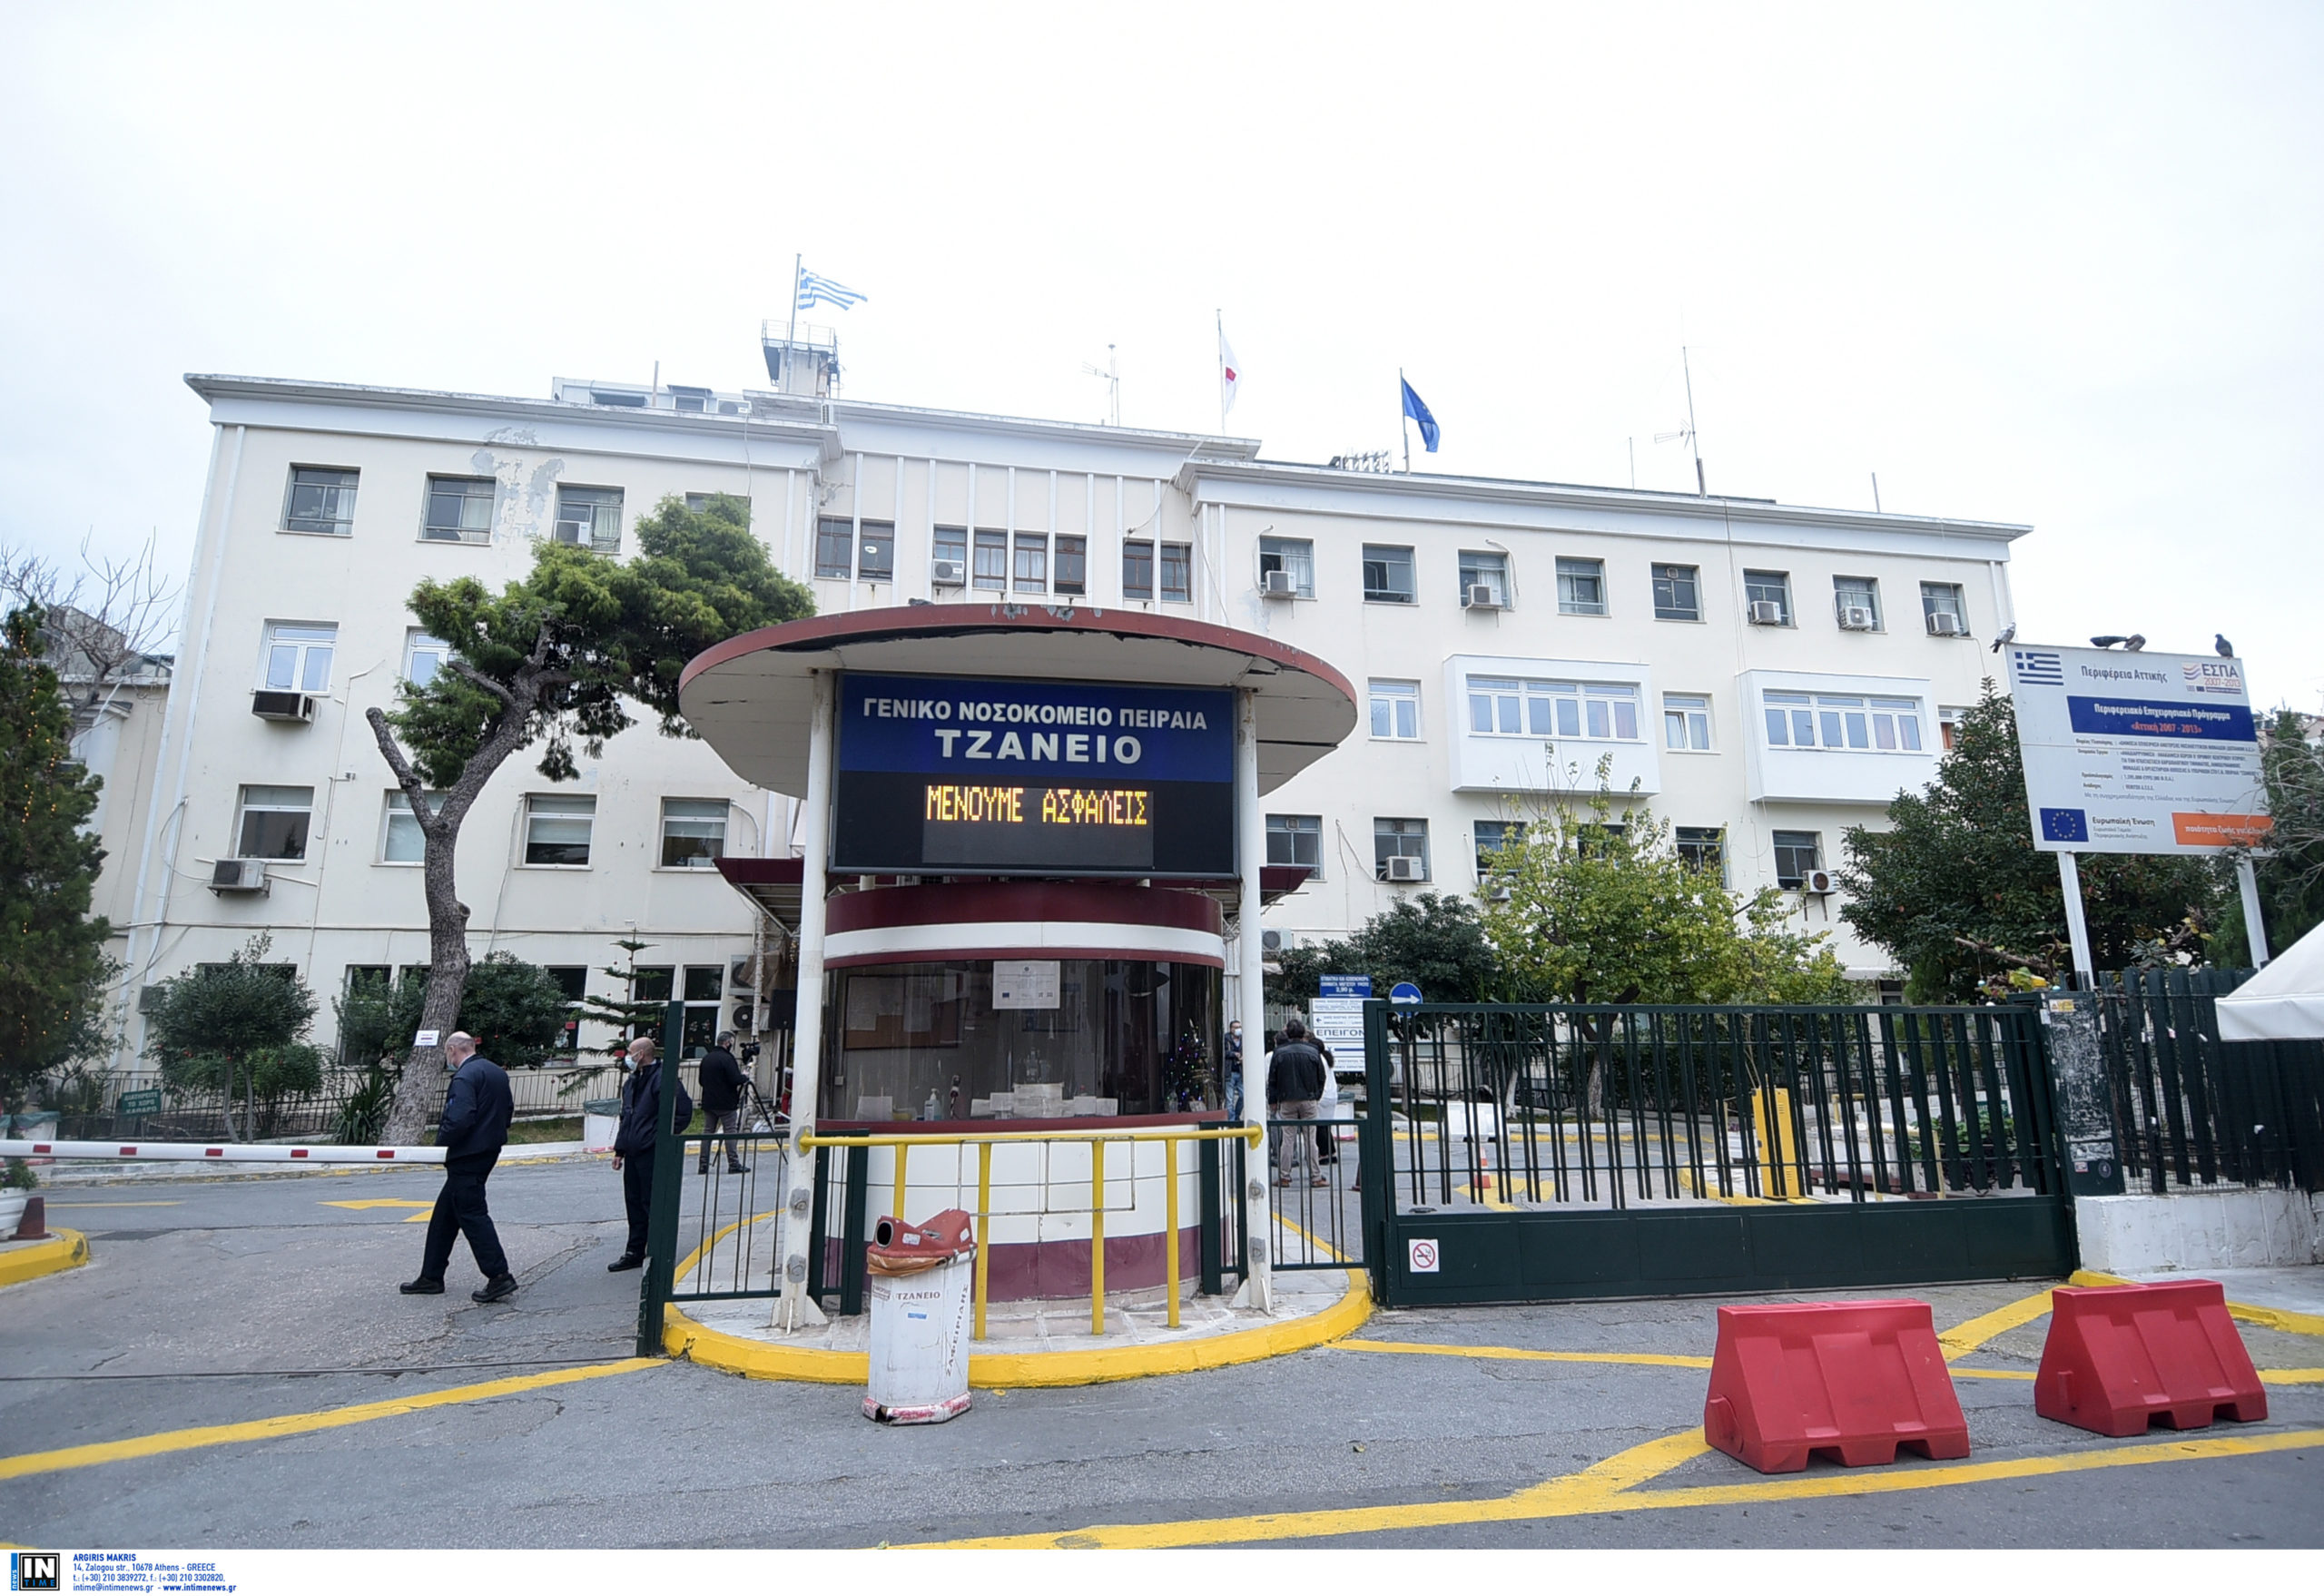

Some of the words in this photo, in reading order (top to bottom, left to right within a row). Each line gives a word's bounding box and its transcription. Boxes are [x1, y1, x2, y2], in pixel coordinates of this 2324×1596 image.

[2081, 665, 2133, 681] Περιφέρεια
[2133, 669, 2168, 684] Αττικής
[2201, 663, 2240, 678] ΕΣΠΑ
[863, 697, 951, 720] ΓΕΝΙΚΟ
[959, 702, 1113, 726] ΝΟΣΟΚΟΜΕΙΟ
[1119, 708, 1207, 730] ΠΕΙΡΑΙΑ
[934, 729, 1142, 764] ΤΖΑΝΕΙΟ
[926, 785, 1024, 822] ΜΕΝΟΥΜΕ
[1042, 789, 1147, 825] ΑΣΦΑΛΕΙΣ
[2093, 817, 2131, 827] Ευρωπαϊκή
[897, 1292, 940, 1300] ΤΖΑΝΕΙΟ
